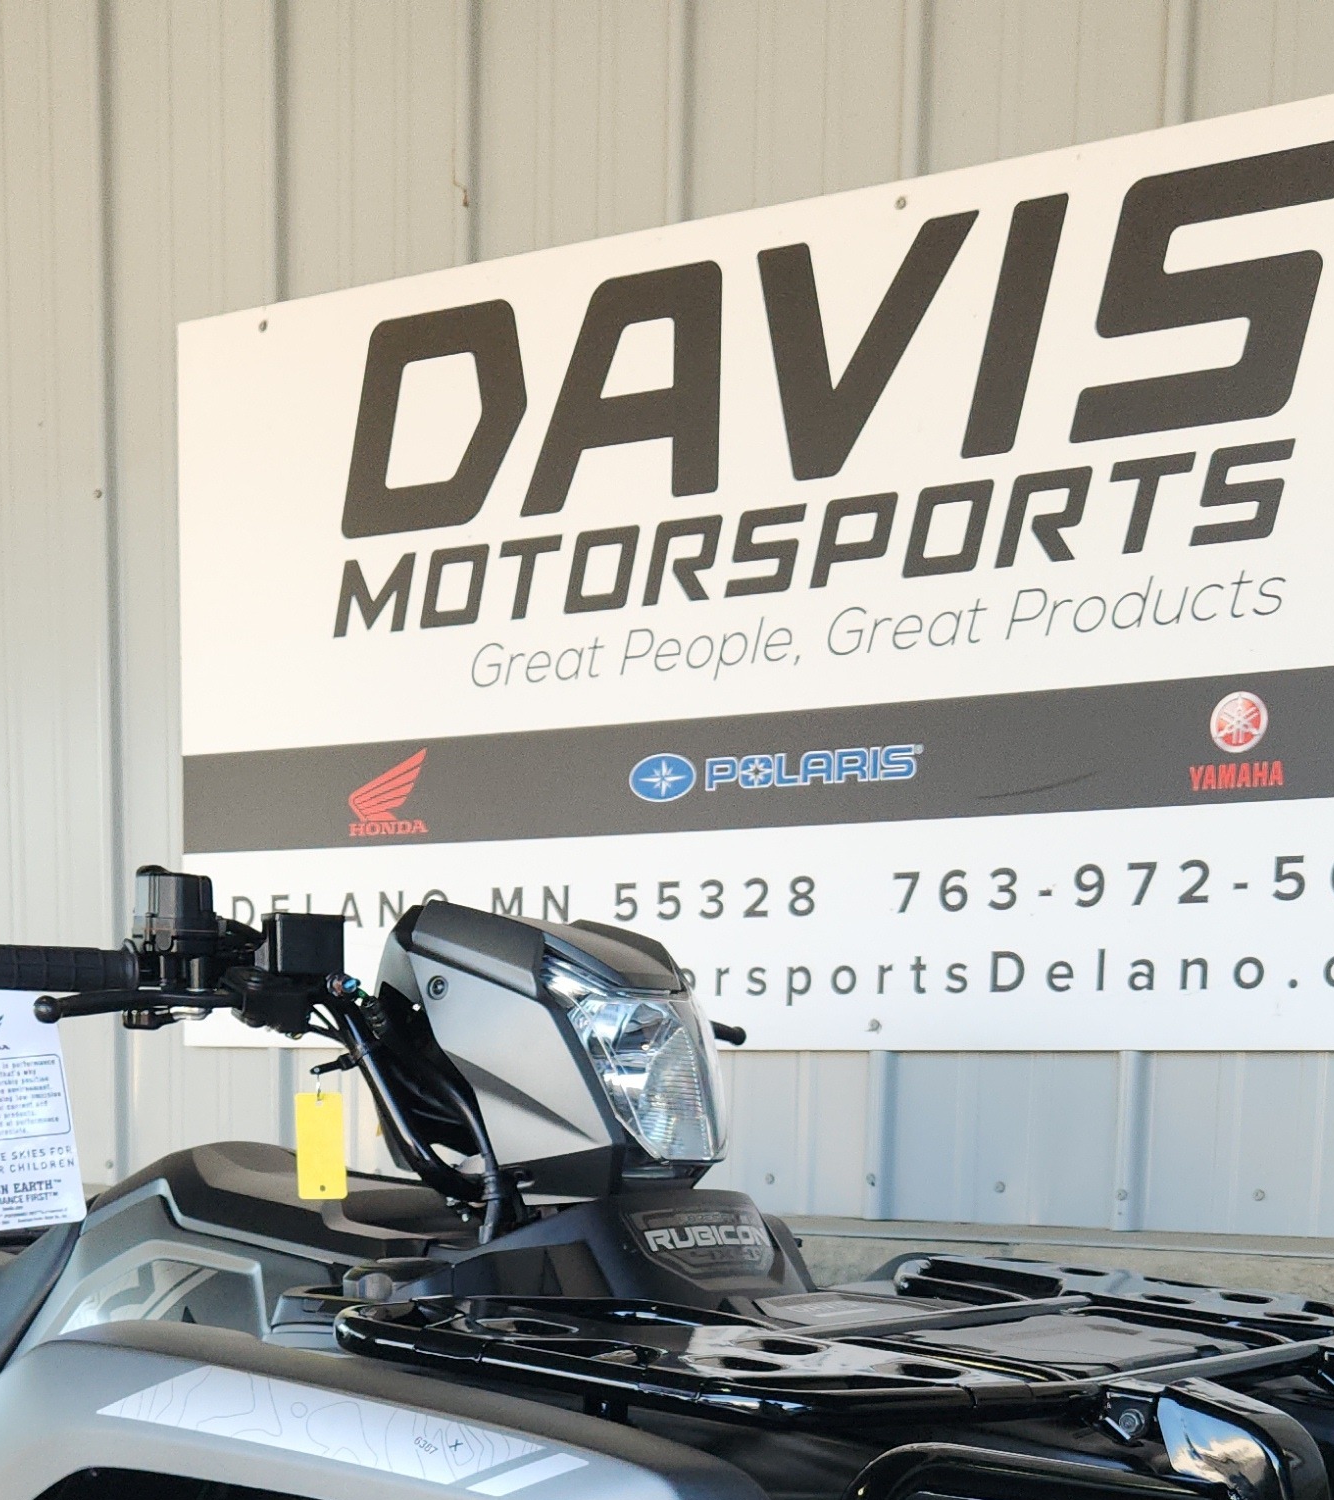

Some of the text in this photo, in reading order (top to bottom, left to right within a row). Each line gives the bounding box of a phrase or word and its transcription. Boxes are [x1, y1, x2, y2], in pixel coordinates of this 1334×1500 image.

[332, 438, 1296, 638] MOTORSPORTS
[470, 569, 1287, 688] Great People, Great Products
[705, 744, 917, 792] POLARIS
[1189, 760, 1284, 791] YAMAHA
[348, 819, 429, 838] HONDA
[491, 884, 571, 925] MN
[613, 875, 816, 922] 55328
[10, 1158, 75, 1173] CHILDREN
[11, 1148, 46, 1160] SKIES
[50, 1145, 72, 1156] FOR
[643, 1225, 772, 1252] RUBICON
